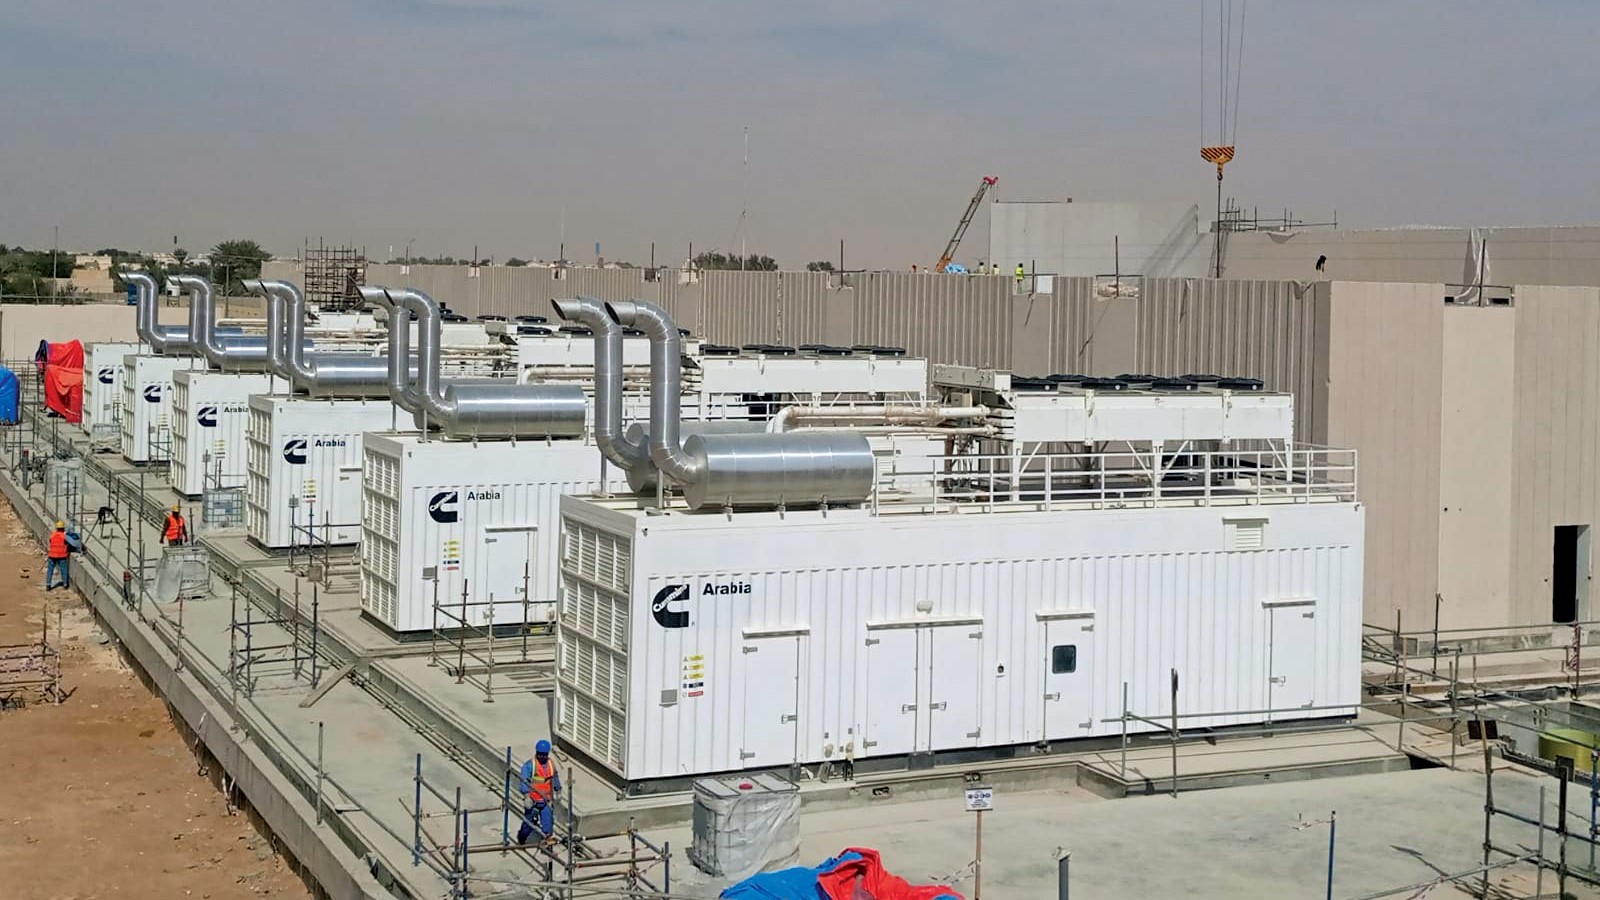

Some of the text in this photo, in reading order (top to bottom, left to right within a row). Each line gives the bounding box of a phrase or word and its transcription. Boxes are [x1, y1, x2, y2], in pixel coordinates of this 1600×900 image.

[315, 439, 346, 447] Arabia
[467, 490, 501, 500] Arabia
[702, 581, 752, 595] Arabia
